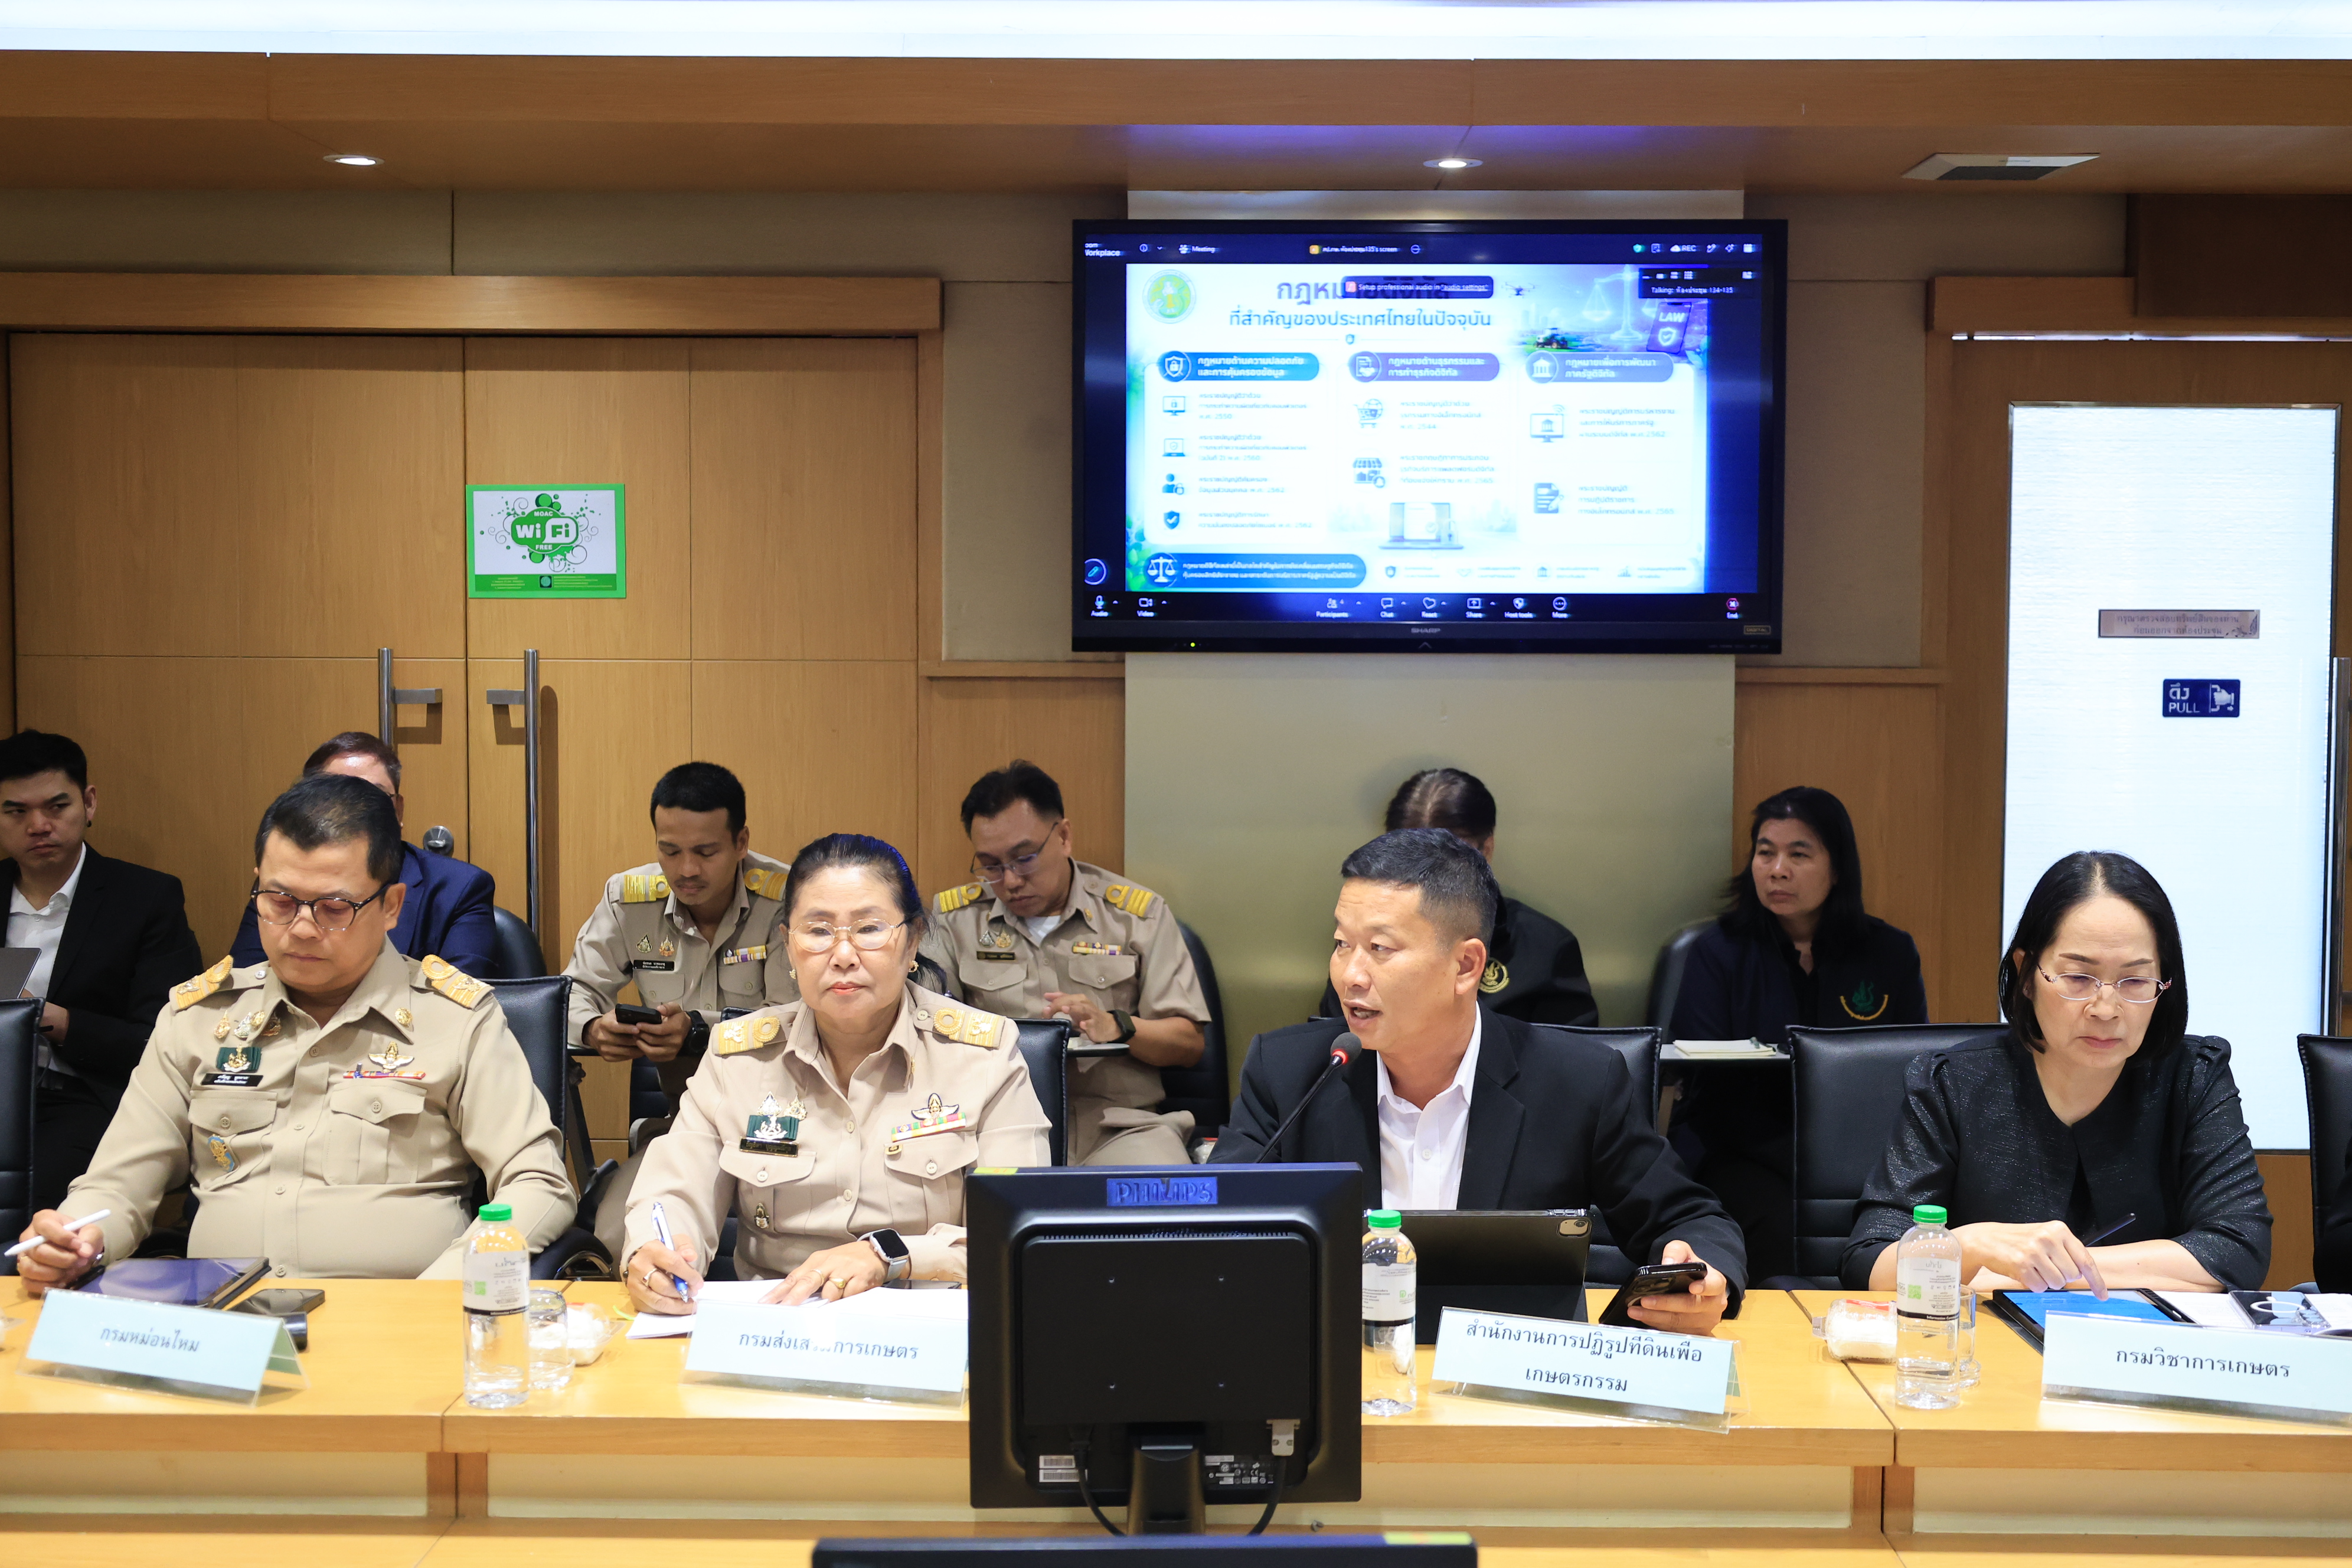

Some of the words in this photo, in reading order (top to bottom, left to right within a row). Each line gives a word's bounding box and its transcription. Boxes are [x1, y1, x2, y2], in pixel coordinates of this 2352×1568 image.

[1651, 286, 1674, 295] Talking:
[1230, 305, 1491, 331] ที่สำคัญของประเทศไทยในปัจจุบัน
[1658, 312, 1685, 322] LAW
[515, 523, 541, 538] Wi
[551, 523, 570, 538] Fi
[2169, 682, 2190, 700] ดึง
[2168, 703, 2200, 713] PULL
[1116, 1181, 1213, 1202] PHILIPS
[100, 1327, 200, 1353] กรมหม่อนไหม
[2116, 1346, 2291, 1378] กรมวิชาการเกษตร
[1525, 1367, 1628, 1392] เกษตรกรรม
